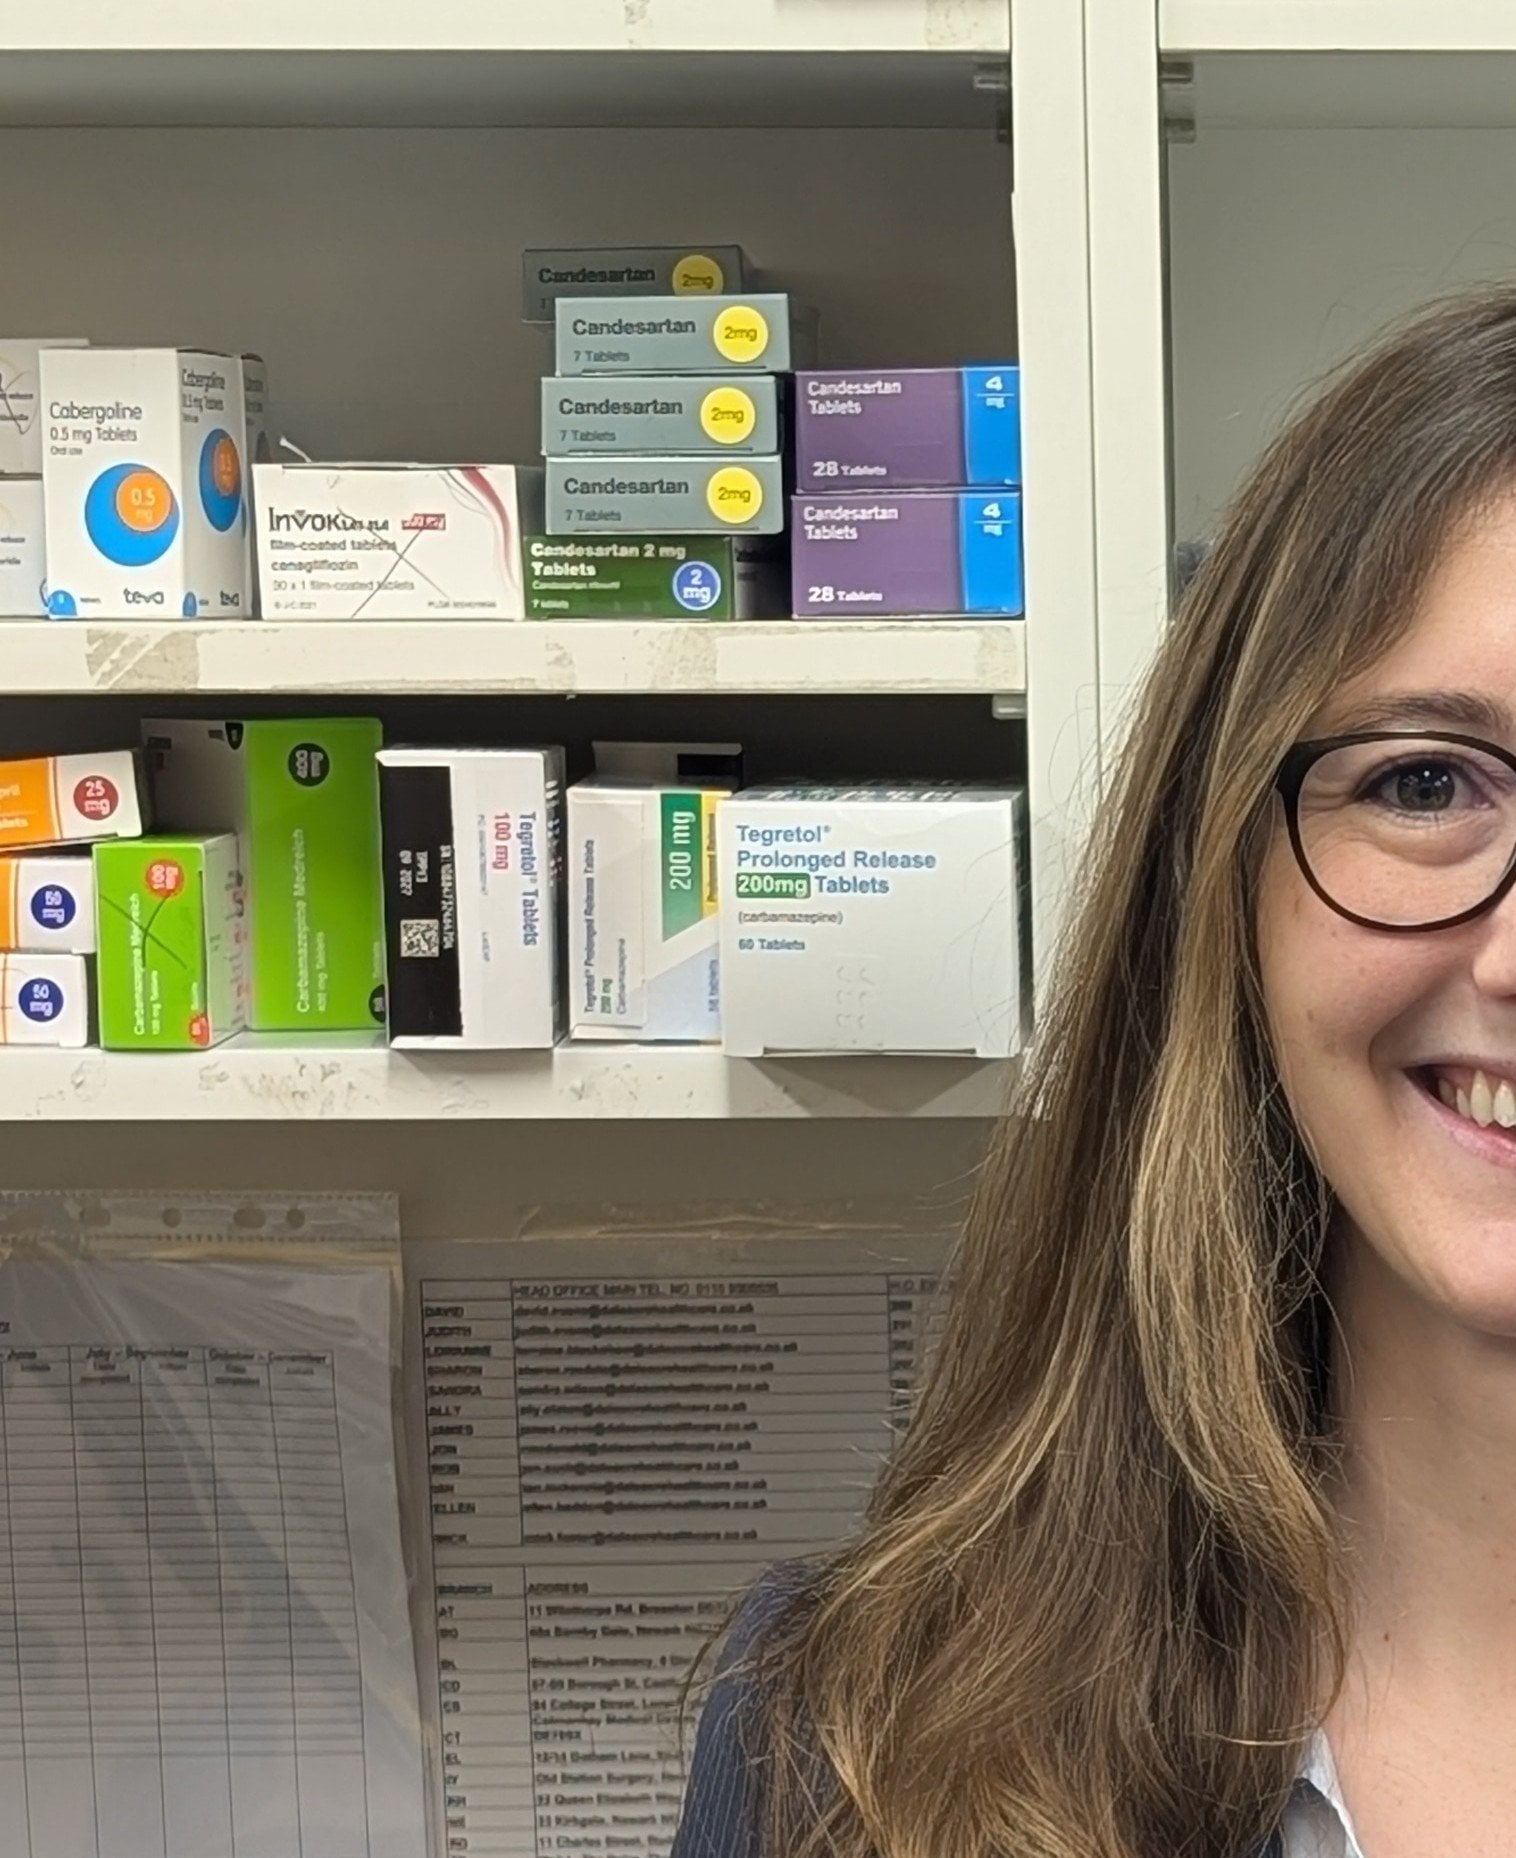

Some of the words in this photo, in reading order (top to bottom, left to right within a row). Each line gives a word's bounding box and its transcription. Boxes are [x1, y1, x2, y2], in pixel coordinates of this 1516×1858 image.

[538, 267, 656, 284] Candesartan
[682, 274, 714, 289] 2mg
[572, 318, 697, 336] Candesartan
[724, 326, 758, 342] 2mg
[584, 350, 630, 362] Tablets
[807, 379, 902, 397] Candesartan
[985, 375, 1004, 391] 4
[50, 402, 143, 424] Cabergoline
[559, 398, 683, 415] Candesartan
[807, 400, 862, 415] Tablets
[711, 407, 745, 424] 2mg
[50, 427, 69, 441] 0.5
[73, 429, 92, 443] mg
[96, 428, 138, 441] Tablets
[571, 430, 617, 442] Tablets
[813, 461, 839, 477] 28
[563, 478, 690, 495] Candesartan
[718, 486, 752, 503] 2mg
[131, 488, 156, 505] 0.5
[576, 509, 622, 522] Tablets
[803, 506, 899, 522] Candesartan
[982, 503, 1001, 519] 4
[804, 525, 858, 540] Tablets
[531, 543, 640, 558] Candesartan
[643, 544, 655, 558] 2
[659, 546, 687, 560] mg
[531, 562, 597, 577] Tablets
[691, 569, 702, 586] 2
[123, 588, 164, 604] teva
[683, 586, 712, 604] mg
[808, 586, 835, 603] 28
[85, 781, 105, 796] 25
[84, 798, 110, 815] mg
[494, 812, 512, 841] 100
[672, 811, 697, 846] mg
[491, 845, 510, 871] mg
[736, 851, 848, 873] Prolonged
[853, 851, 937, 869] Release
[151, 864, 166, 890] 100
[669, 850, 693, 890] 200
[737, 874, 809, 897] 200mg
[814, 874, 889, 894] Tablets
[522, 889, 540, 947] Tablets
[758, 938, 806, 951] Tablets
[33, 983, 50, 999] 50
